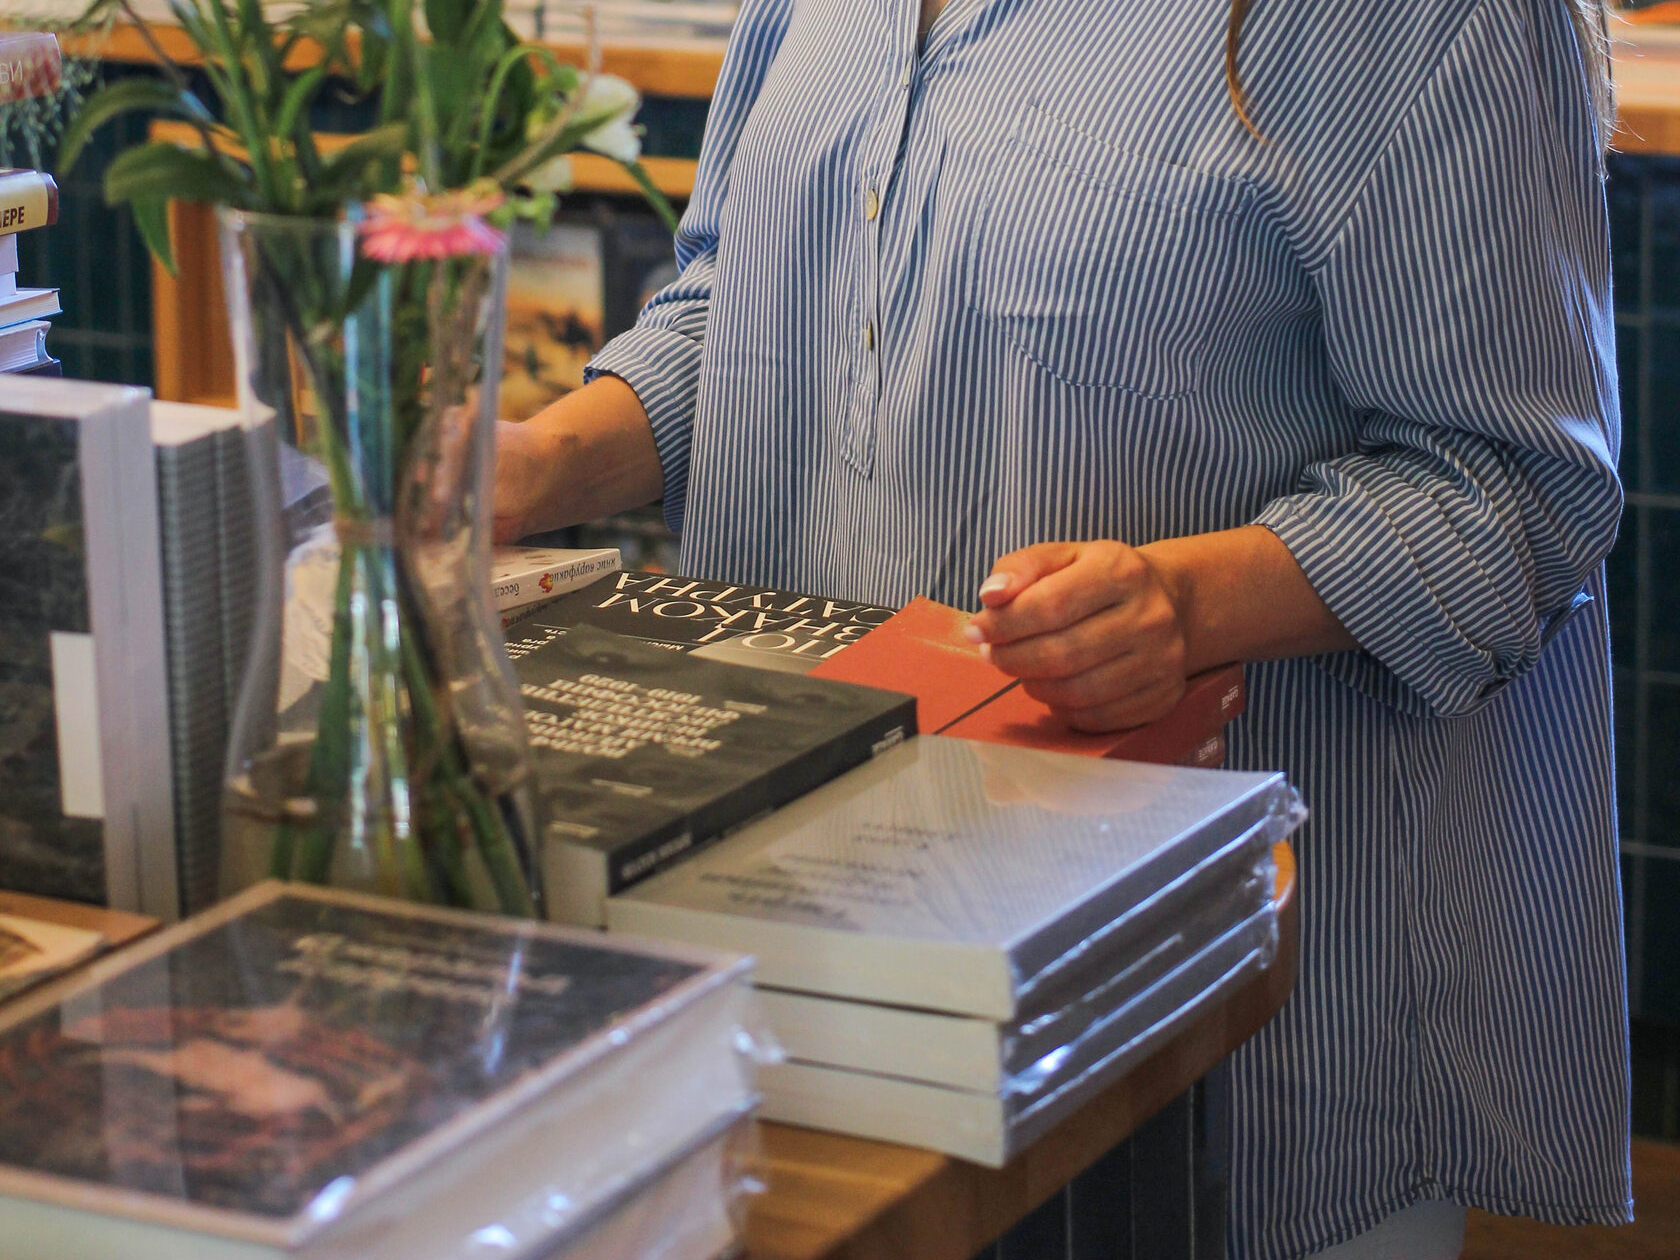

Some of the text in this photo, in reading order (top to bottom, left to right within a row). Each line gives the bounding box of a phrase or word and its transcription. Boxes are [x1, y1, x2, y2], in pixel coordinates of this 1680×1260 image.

[0, 206, 25, 229] ЕРЕ
[592, 593, 875, 642] ЗНАКОМ
[615, 572, 899, 626] САТУРНА
